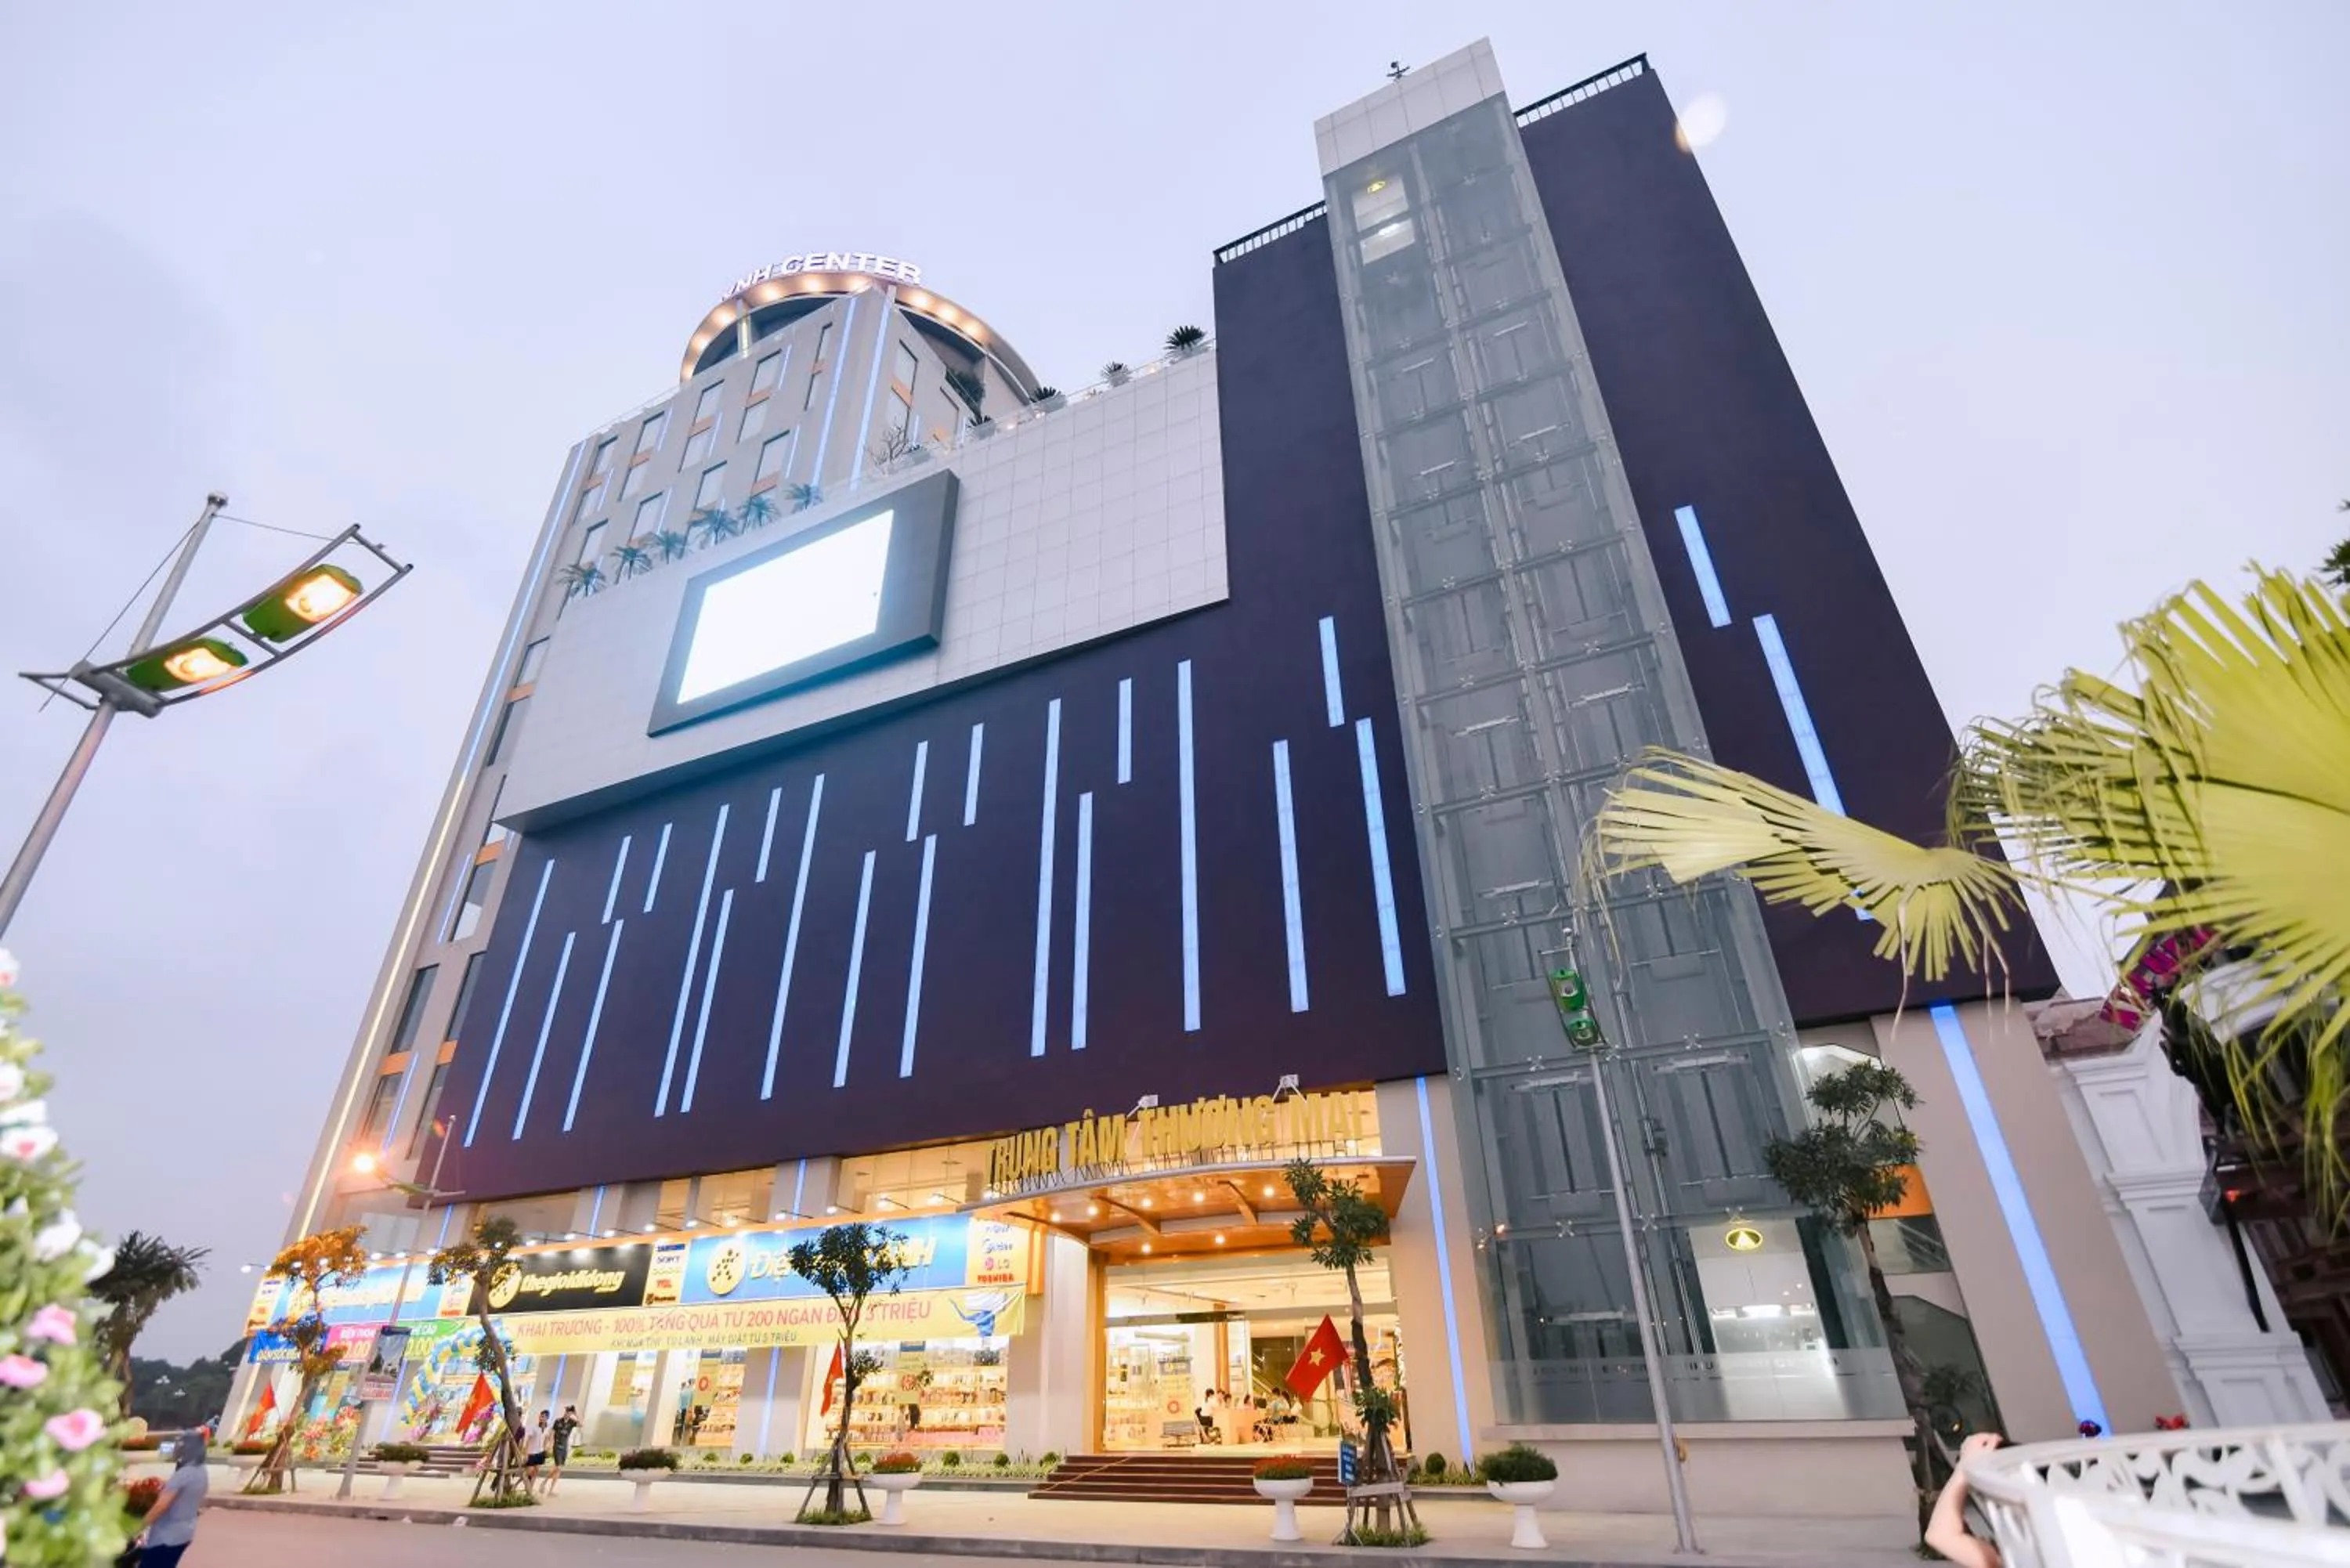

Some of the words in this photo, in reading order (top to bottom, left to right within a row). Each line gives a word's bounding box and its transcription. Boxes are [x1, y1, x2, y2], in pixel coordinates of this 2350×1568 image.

[782, 251, 922, 285] CENTER
[985, 1127, 1058, 1185] TRUNG
[1065, 1108, 1126, 1167] TÂM
[1137, 1094, 1276, 1156] THƯƠNG
[517, 1321, 548, 1338] KHAI
[747, 1310, 774, 1328] 200
[880, 1297, 931, 1324] TRIỆU
